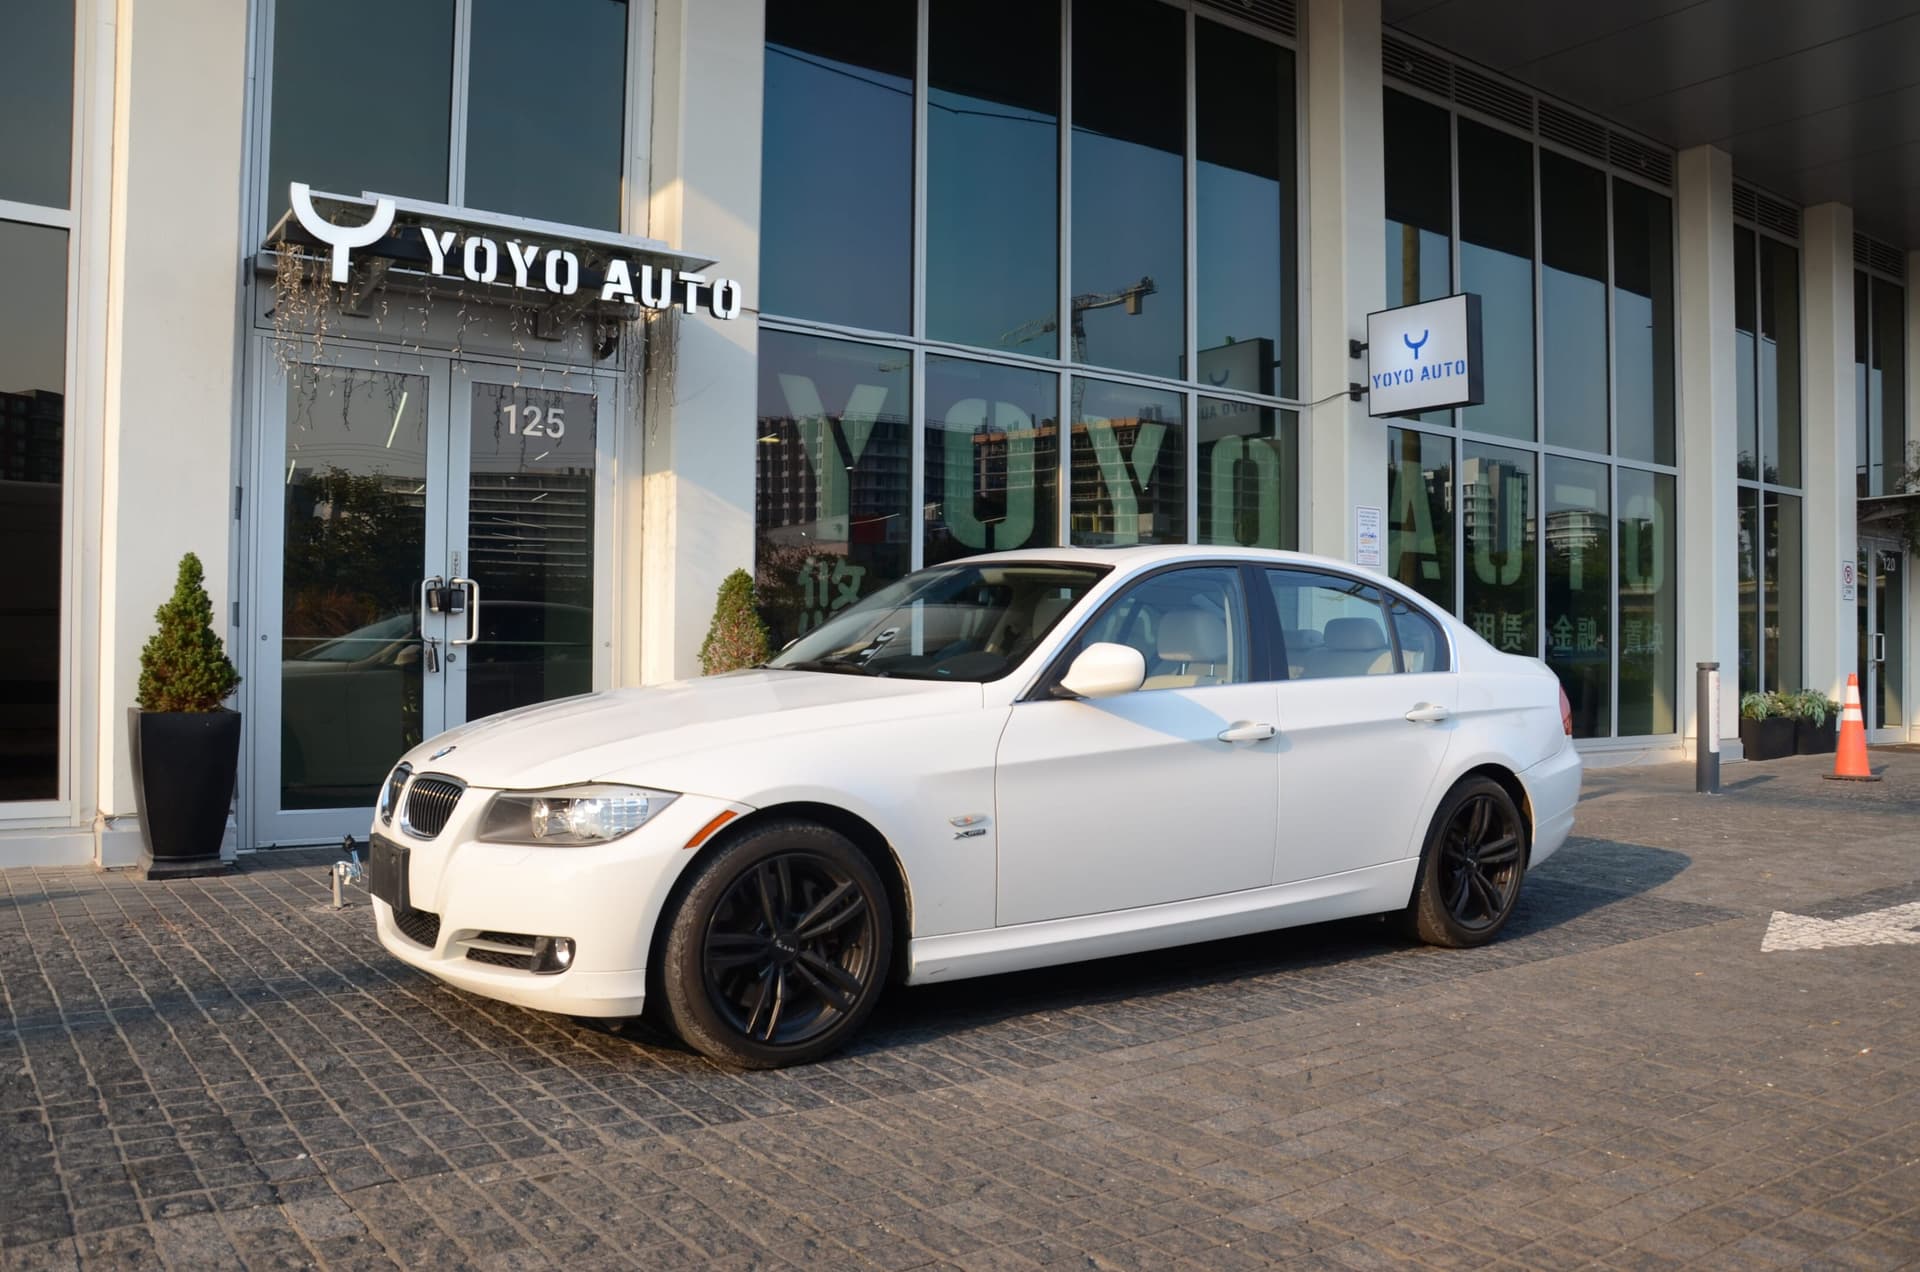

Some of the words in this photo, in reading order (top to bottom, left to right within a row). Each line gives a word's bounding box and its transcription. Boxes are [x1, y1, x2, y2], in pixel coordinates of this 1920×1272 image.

[420, 227, 579, 296] YOYO
[601, 259, 742, 321] AUTO
[1372, 367, 1414, 389] YOYO
[1420, 359, 1466, 381] AUTO
[502, 404, 566, 439] 125
[778, 373, 1282, 550] YOYO
[1388, 461, 1665, 594] AUTO
[1882, 557, 1896, 571] 120
[1553, 614, 1599, 652] 金融
